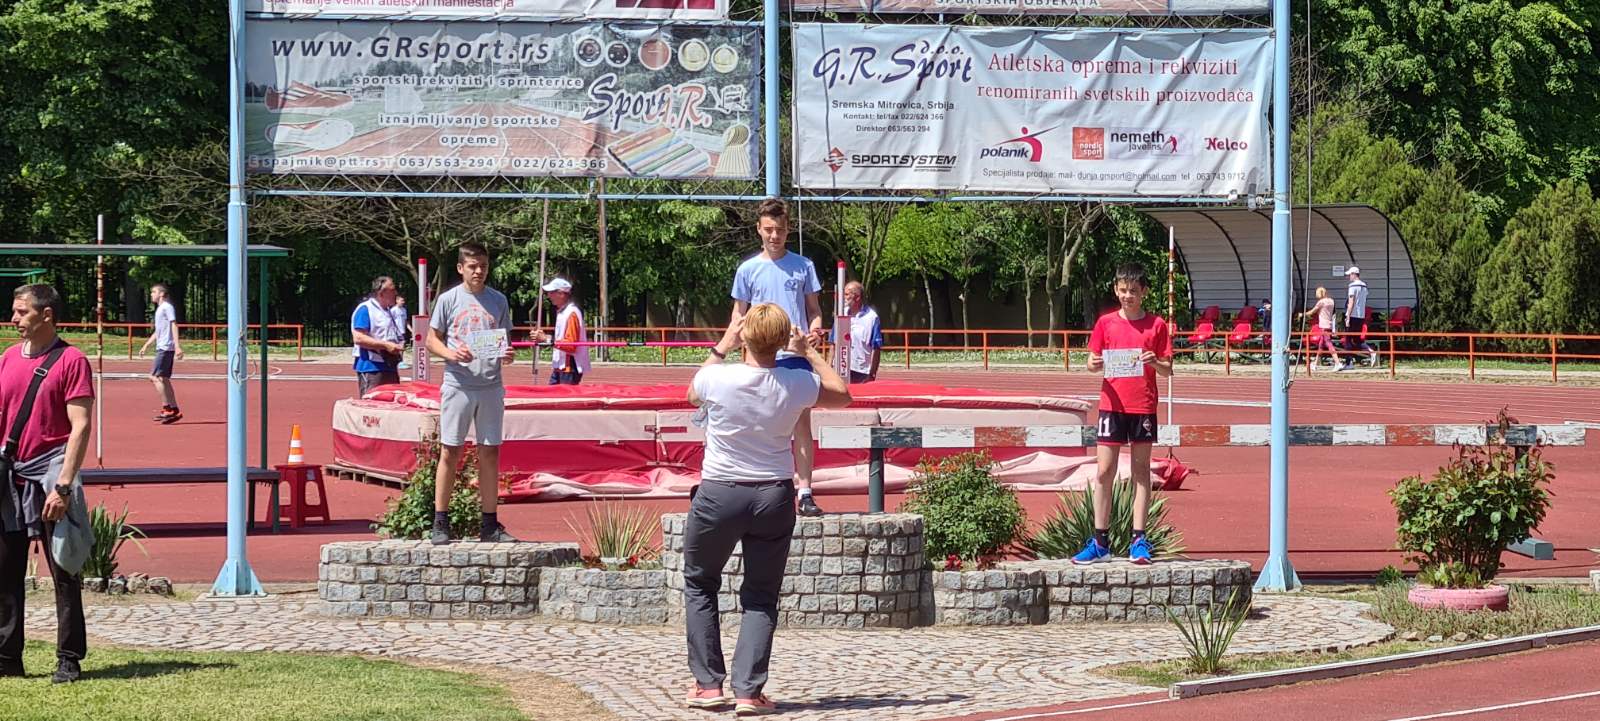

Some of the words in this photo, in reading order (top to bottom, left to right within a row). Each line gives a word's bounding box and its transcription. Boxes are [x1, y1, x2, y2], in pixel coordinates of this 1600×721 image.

[272, 37, 549, 63] www.GRsport.rs
[988, 53, 1065, 73] Atletska
[1072, 59, 1149, 78] oprema
[1149, 57, 1155, 74] i
[1161, 57, 1239, 76] rekviziti
[354, 76, 416, 87] sportski
[421, 75, 483, 86] rekviziti
[489, 76, 493, 86] i
[500, 77, 583, 89] sprinterice
[977, 85, 1078, 101] renomiranih
[1084, 87, 1150, 102] svetskih
[1156, 88, 1254, 106] proizvodača
[832, 100, 875, 109] Sremska
[878, 101, 925, 111] Mitrovica,
[927, 101, 955, 111] Srbija
[379, 114, 488, 127] iznajmljivanje
[493, 116, 558, 128] sportske
[856, 124, 886, 132] Direktor
[441, 135, 497, 146] opreme
[1111, 131, 1165, 143] nemeth
[1205, 137, 1248, 150] Nelco
[980, 146, 1029, 160] polanik
[399, 157, 494, 168] 063/563-294
[514, 158, 605, 169] 022/624-366
[852, 154, 957, 167] SPORTSYSTEM
[983, 167, 1024, 178] Specijalista
[1097, 417, 1111, 437] 11
